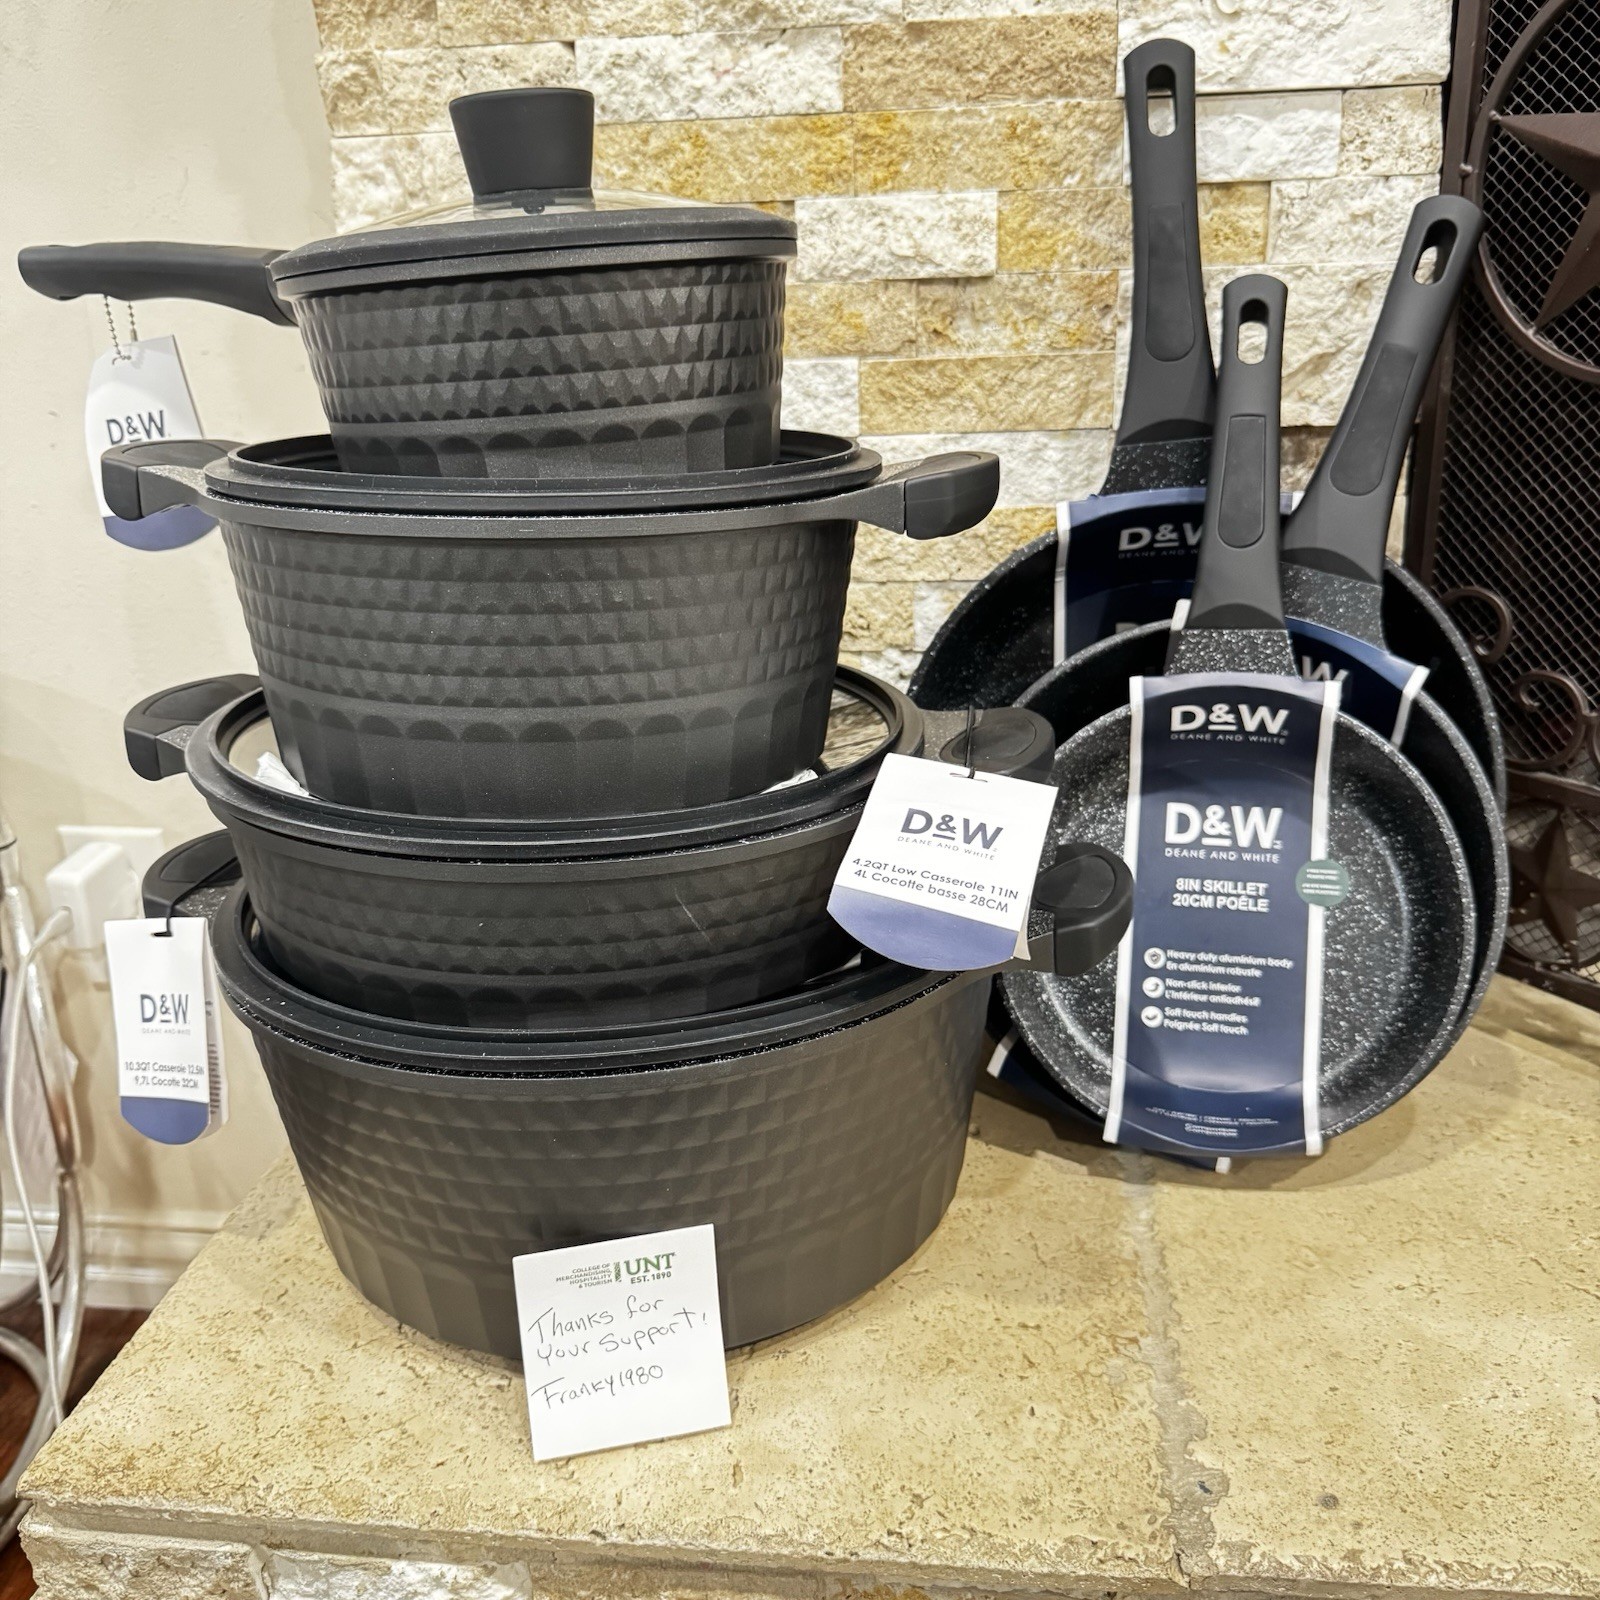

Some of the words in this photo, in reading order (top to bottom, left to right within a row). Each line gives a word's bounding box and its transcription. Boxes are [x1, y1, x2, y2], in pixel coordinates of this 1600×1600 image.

[106, 410, 165, 445] D&W
[1118, 551, 1156, 559] DEANE
[1170, 703, 1290, 735] D&W
[1170, 732, 1212, 741] DEANE
[1216, 733, 1243, 742] AND
[1248, 735, 1286, 745] WHITE
[900, 808, 1004, 851] D&W
[1164, 802, 1284, 850] D&W
[897, 835, 932, 847] DEANE
[937, 842, 959, 852] AND
[964, 848, 995, 861] WHITE
[1165, 847, 1206, 860] DEANE
[1210, 851, 1237, 861] AND
[1241, 852, 1280, 864] WHITE
[852, 857, 889, 872] 4.2QT
[892, 865, 917, 877] Low
[920, 870, 985, 893] Casserole
[991, 885, 1019, 900] 11IN
[1175, 877, 1201, 893] 8IN
[1202, 879, 1269, 897] SKILLET
[854, 869, 868, 880] 4L
[871, 872, 924, 892] Cocotte
[927, 883, 967, 902] basse
[969, 894, 1009, 914] 28CM
[1172, 893, 1215, 909] 20CM
[1166, 949, 1196, 961] Heavy
[1197, 951, 1219, 963] duty
[140, 993, 190, 1025] D&W
[624, 1252, 676, 1276] UNT
[570, 1273, 612, 1285] HOSPITALITY
[630, 1276, 650, 1285] EST.
[652, 1270, 672, 1281] 1890
[528, 1307, 614, 1344] Thanks
[626, 1295, 664, 1319] for
